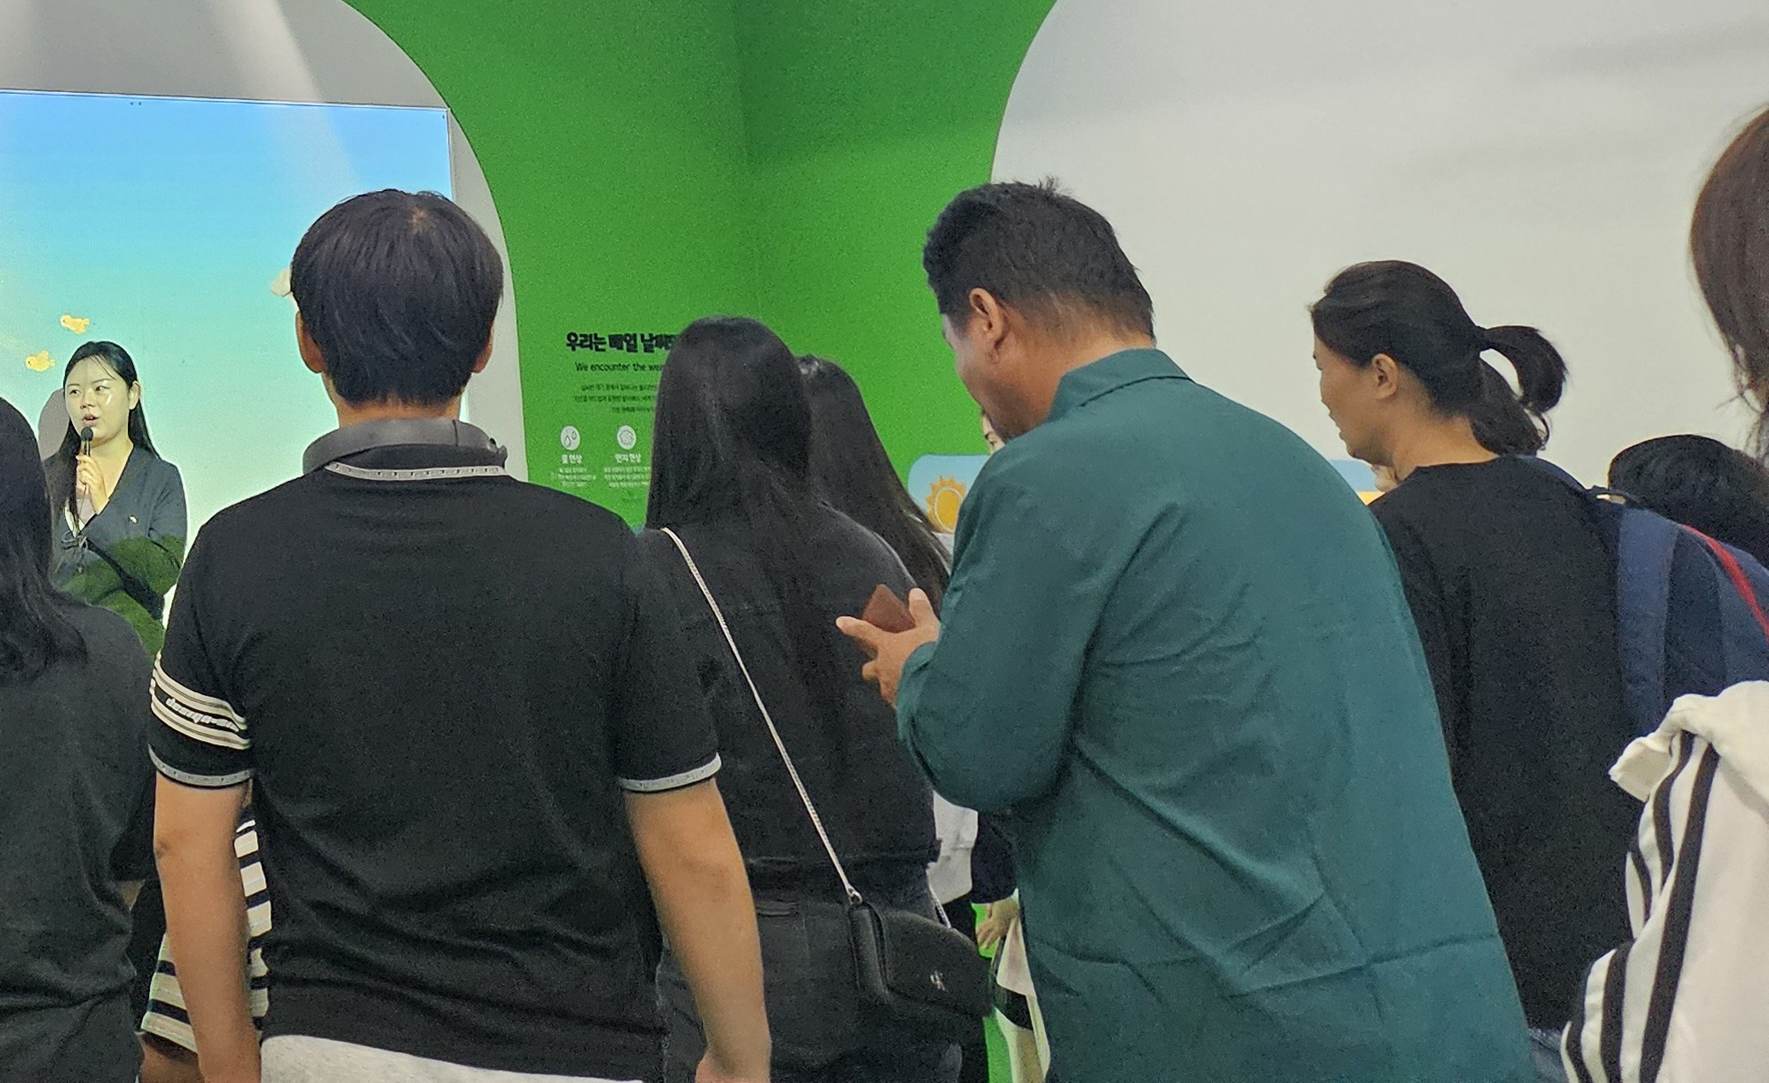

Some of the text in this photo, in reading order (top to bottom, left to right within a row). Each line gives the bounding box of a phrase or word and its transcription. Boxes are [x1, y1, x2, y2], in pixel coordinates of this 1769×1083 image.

[566, 331, 606, 352] 우리는
[575, 362, 588, 371] We
[590, 363, 630, 372] encounter
[633, 362, 646, 372] the
